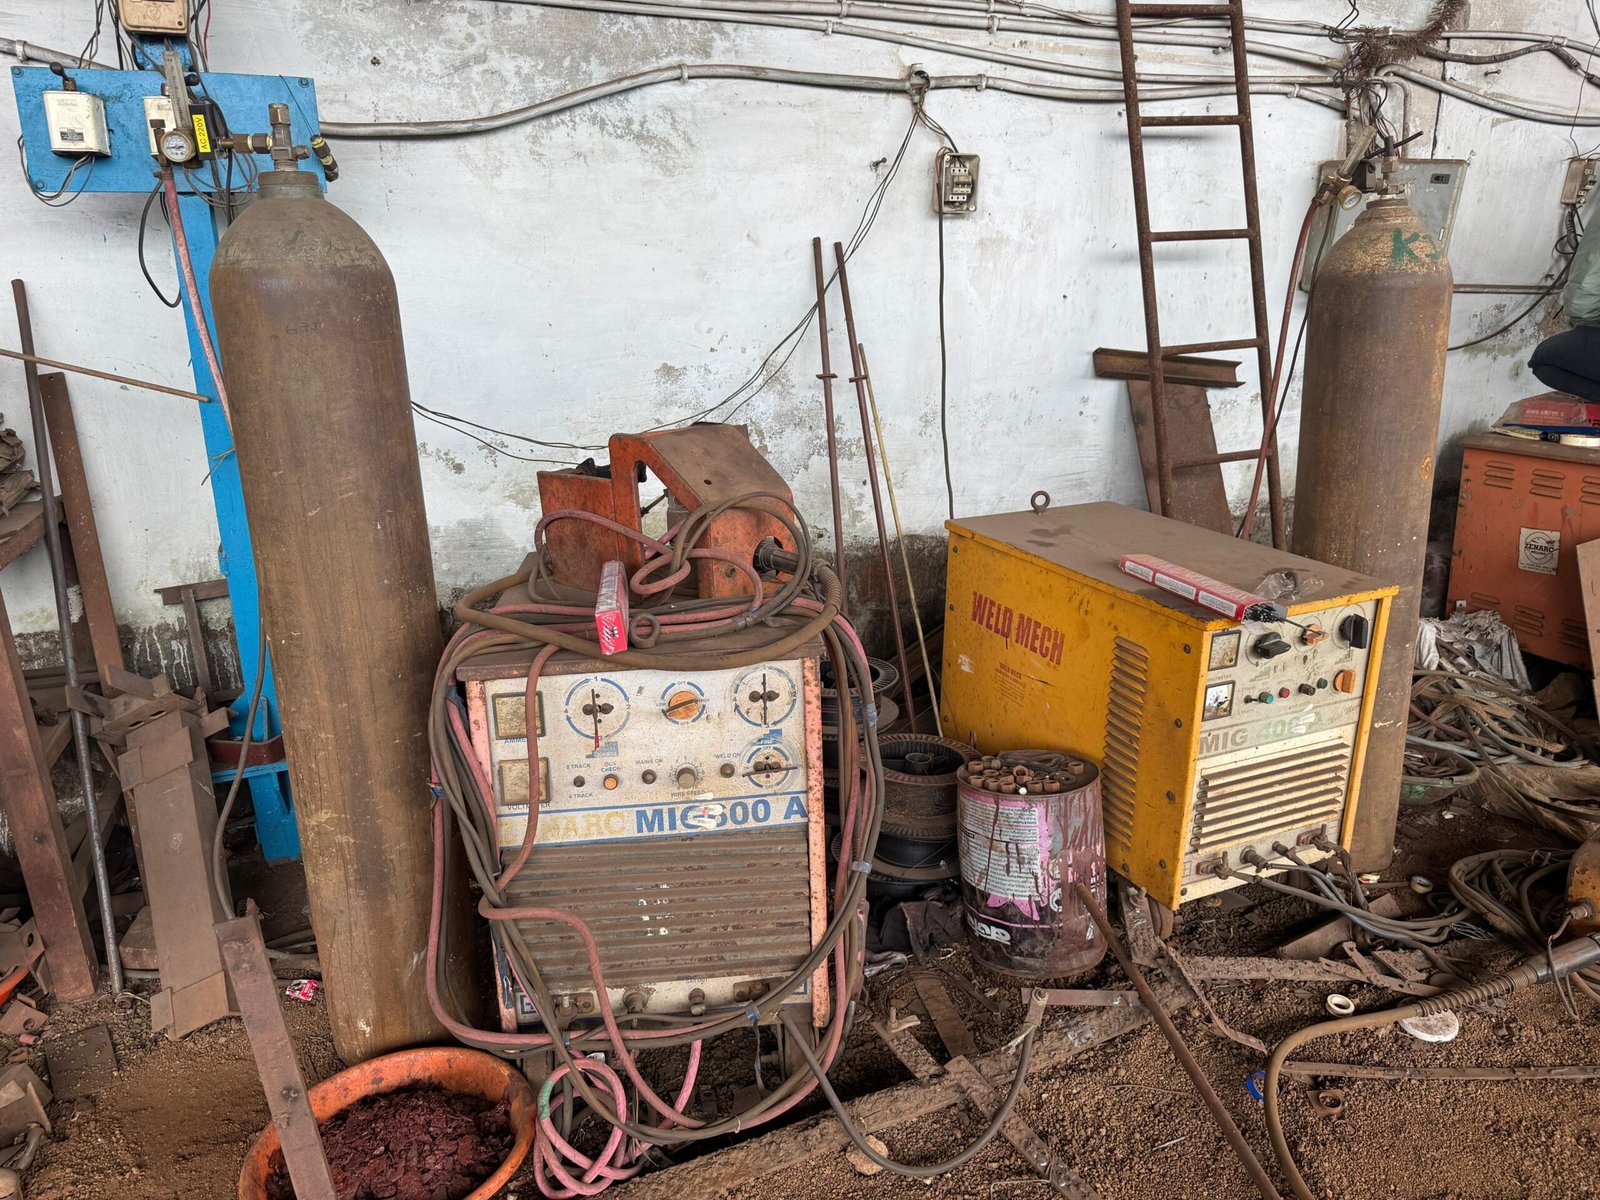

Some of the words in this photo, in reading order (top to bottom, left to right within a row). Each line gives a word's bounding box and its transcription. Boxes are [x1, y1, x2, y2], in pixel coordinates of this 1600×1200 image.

[195, 117, 206, 137] 220V
[200, 138, 208, 150] AC
[1524, 543, 1554, 553] ZENARC
[972, 590, 1014, 638] WELD
[1015, 613, 1066, 666] MECH
[504, 736, 540, 744] AMMER
[1199, 728, 1248, 754] MIG
[636, 804, 704, 833] MIG
[783, 796, 808, 820] A
